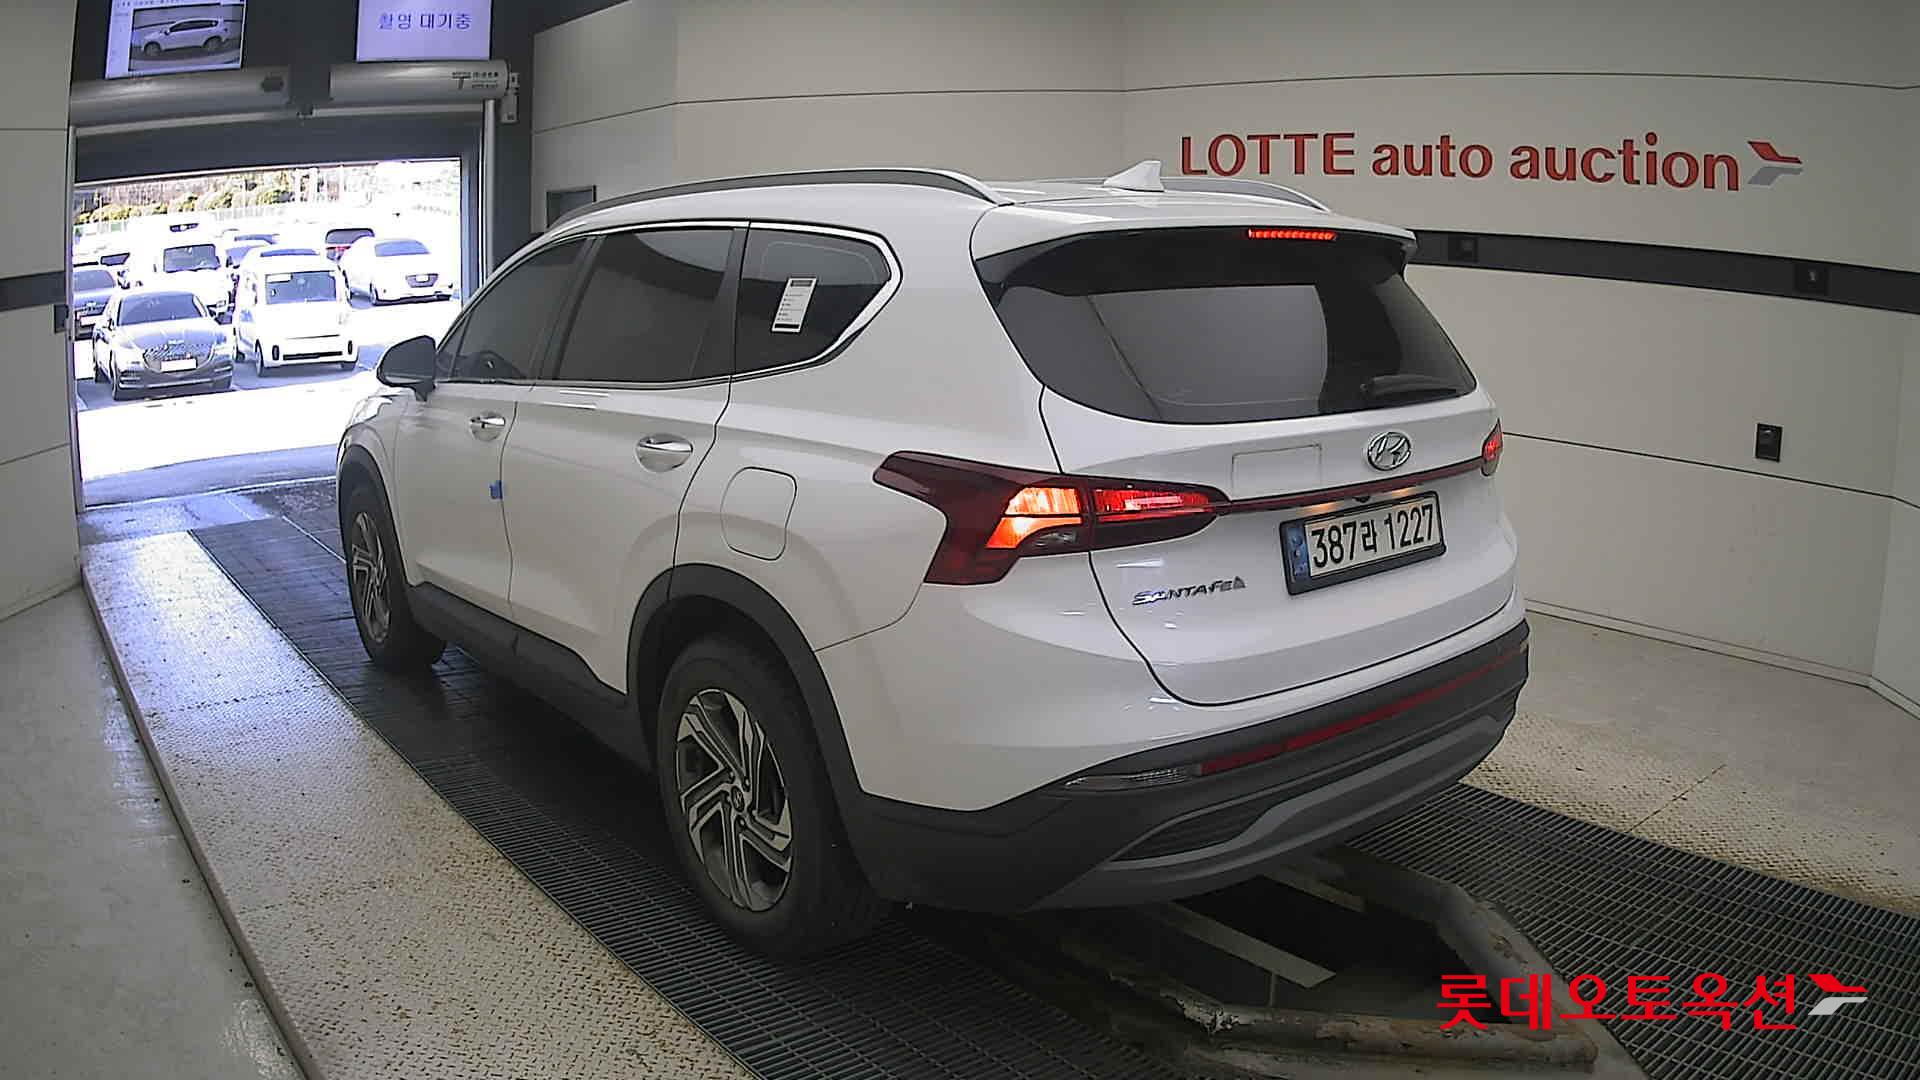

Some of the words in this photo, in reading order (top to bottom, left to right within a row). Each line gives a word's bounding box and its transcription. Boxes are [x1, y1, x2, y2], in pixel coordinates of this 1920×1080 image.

[1181, 133, 1356, 177] LOTTE
[1371, 136, 1494, 179] auto
[1511, 132, 1740, 190] auction
[1310, 518, 1377, 568] 387라
[1383, 503, 1434, 549] 1227
